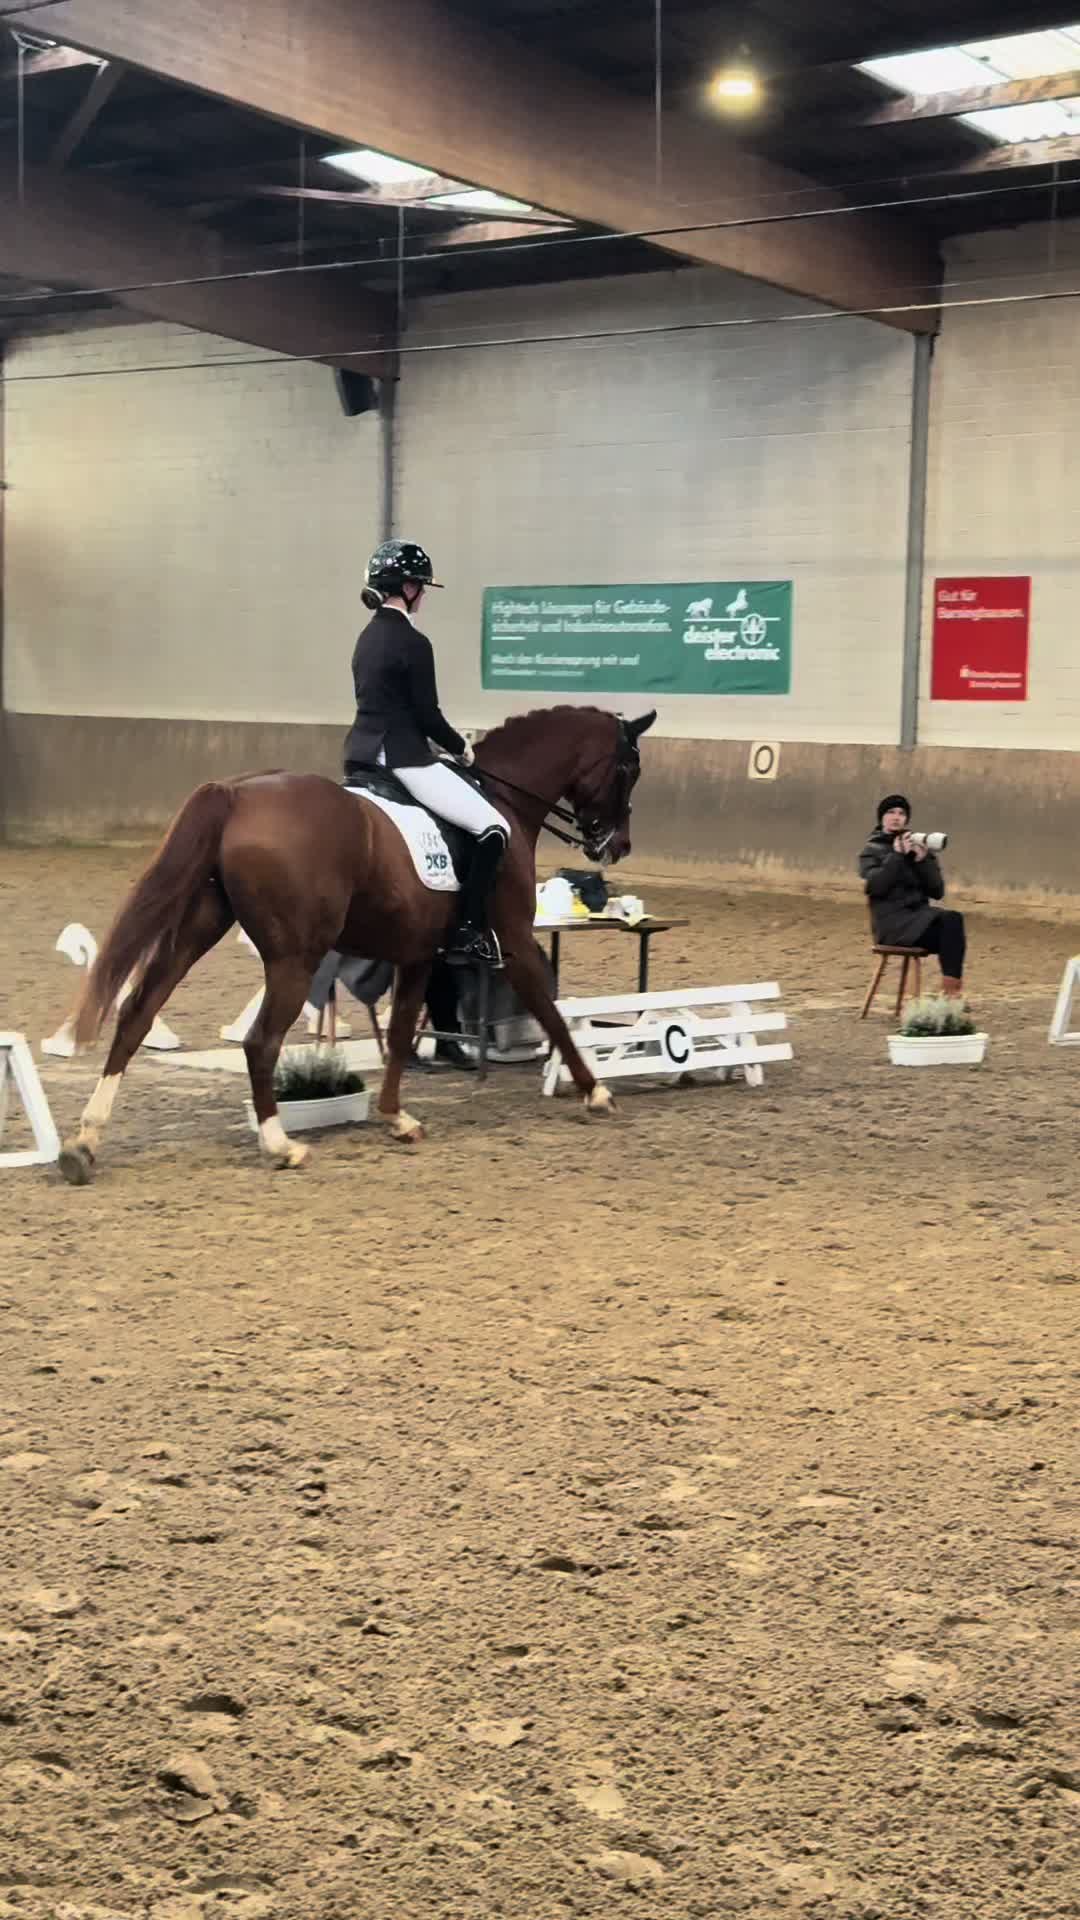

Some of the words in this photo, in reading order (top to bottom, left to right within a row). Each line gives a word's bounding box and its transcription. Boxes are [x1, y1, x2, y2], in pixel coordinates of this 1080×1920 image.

[938, 590, 959, 602] Gut
[595, 600, 611, 614] für
[704, 642, 780, 661] electronic
[424, 853, 448, 870] DKB
[665, 1024, 689, 1064] C
